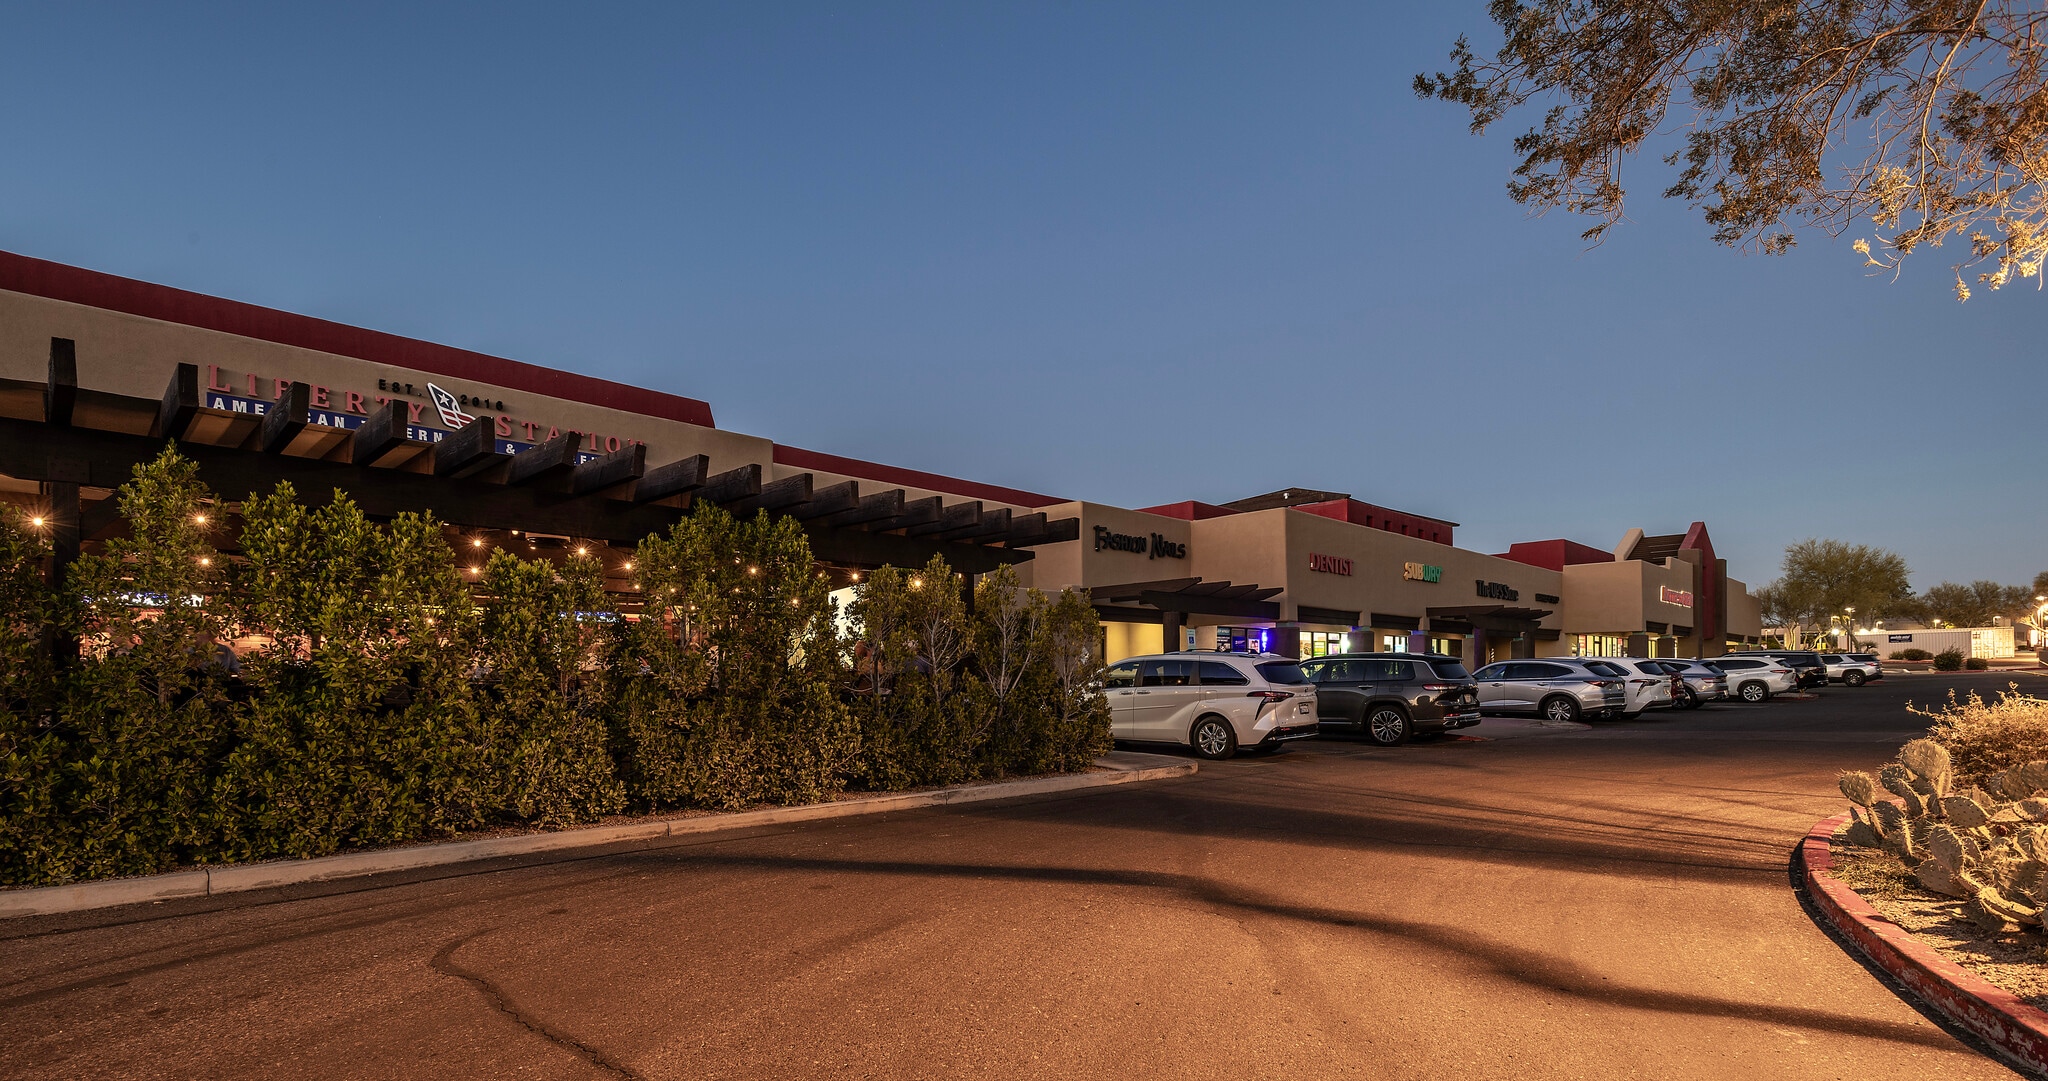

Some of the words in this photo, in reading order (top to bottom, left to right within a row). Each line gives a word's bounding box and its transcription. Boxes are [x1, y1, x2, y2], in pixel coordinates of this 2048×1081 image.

[379, 379, 422, 396] EST.
[460, 395, 503, 410] 2016
[212, 397, 345, 429] AMEAN
[506, 443, 515, 455] &
[496, 415, 644, 453] STAIO
[1310, 553, 1354, 576] DENTIST
[1403, 562, 1442, 583] SUBWAY
